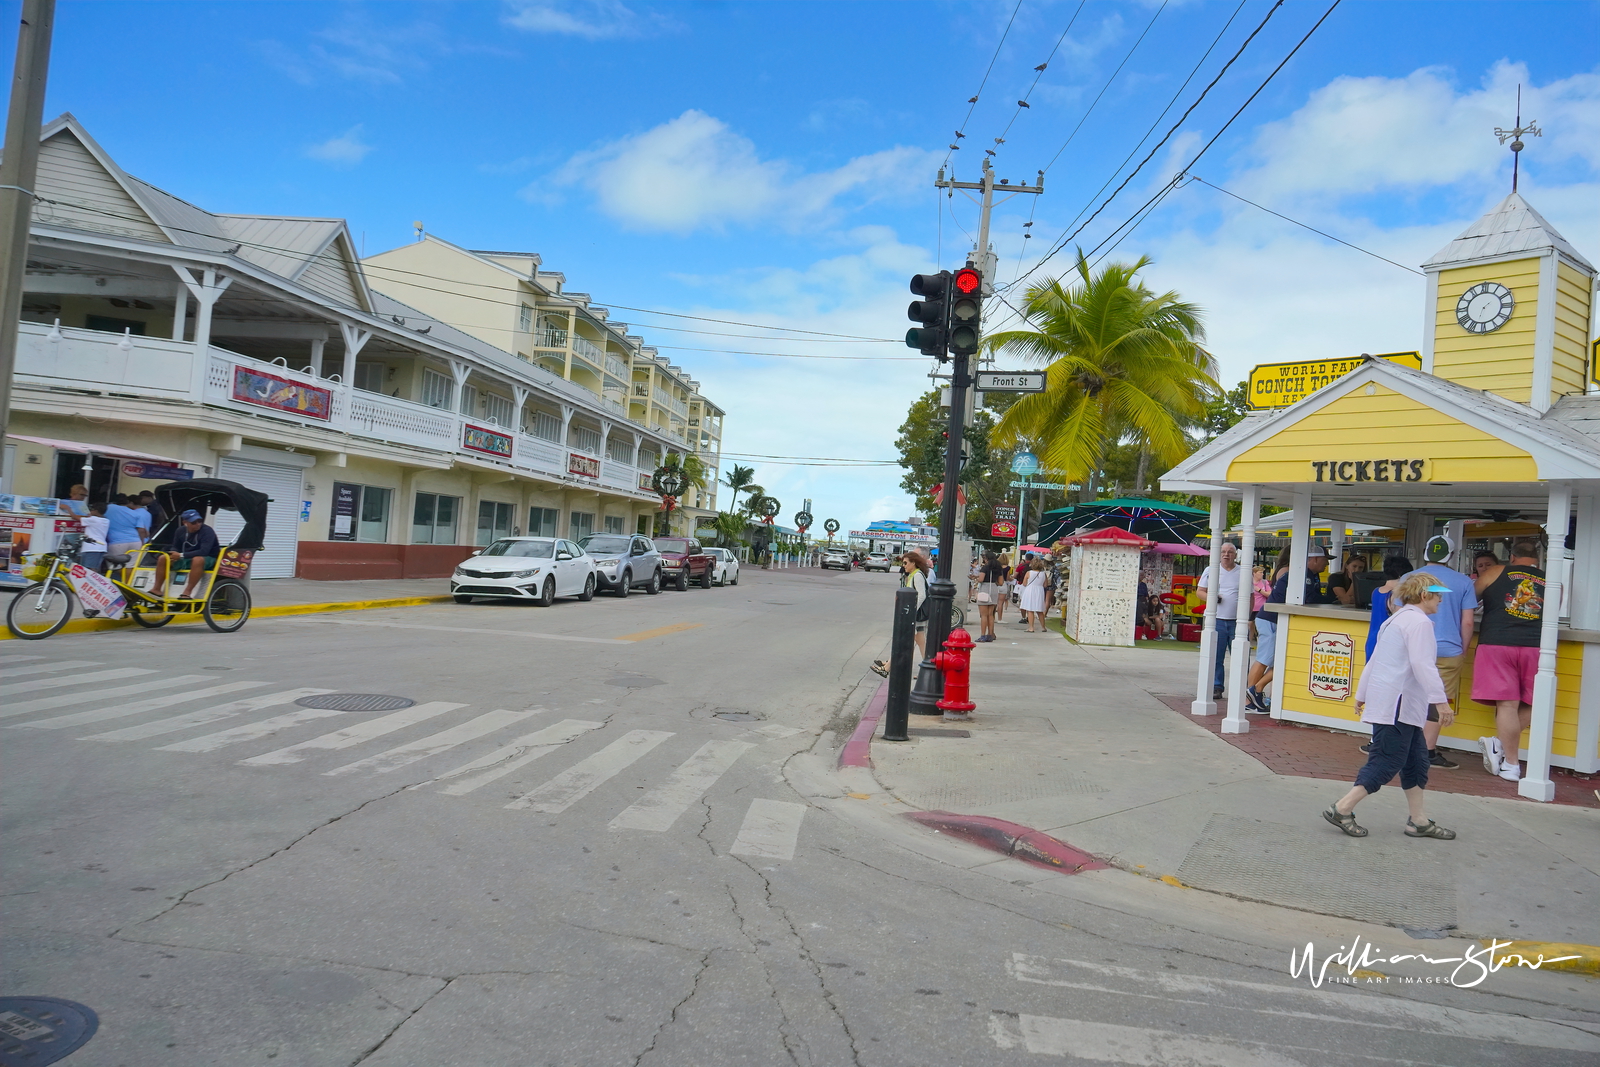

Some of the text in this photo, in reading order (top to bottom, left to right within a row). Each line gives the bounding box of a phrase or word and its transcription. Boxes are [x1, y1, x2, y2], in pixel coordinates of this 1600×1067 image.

[1280, 362, 1361, 377] WORLD FAM
[992, 376, 1028, 386] Front St
[1256, 374, 1344, 394] CONCH TO
[1282, 394, 1307, 403] KEY
[1312, 459, 1424, 482] TICKETS
[851, 531, 906, 539] GLASSBOTTOM
[1434, 544, 1442, 552] P
[81, 582, 111, 607] REPAIR
[1313, 654, 1350, 667] SUPER
[1312, 664, 1350, 677] SAVER
[1313, 675, 1348, 685] PACKAGES
